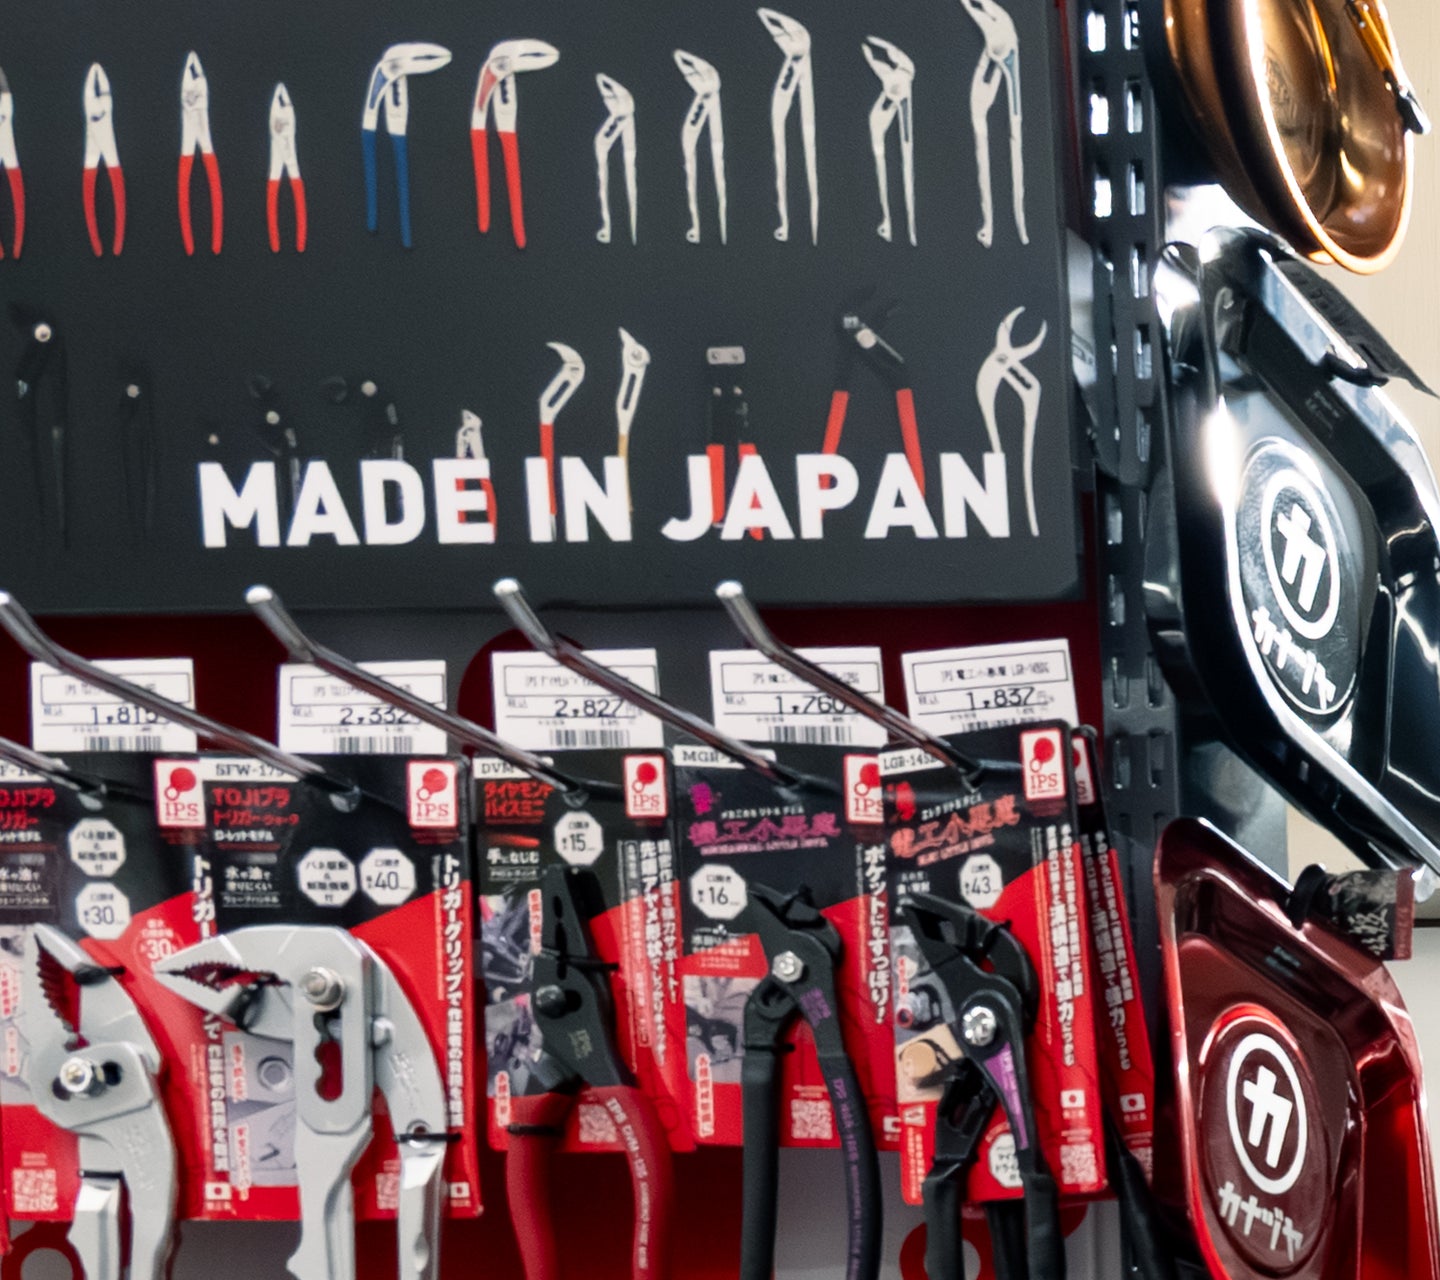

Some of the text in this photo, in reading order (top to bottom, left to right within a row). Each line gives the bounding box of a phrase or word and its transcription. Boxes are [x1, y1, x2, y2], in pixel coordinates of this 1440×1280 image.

[200, 452, 1011, 548] MADE IN JAPAN
[1029, 774, 1059, 791] IPS
[632, 793, 661, 809] IPS
[164, 801, 199, 819] IPS
[415, 802, 451, 819] IPS
